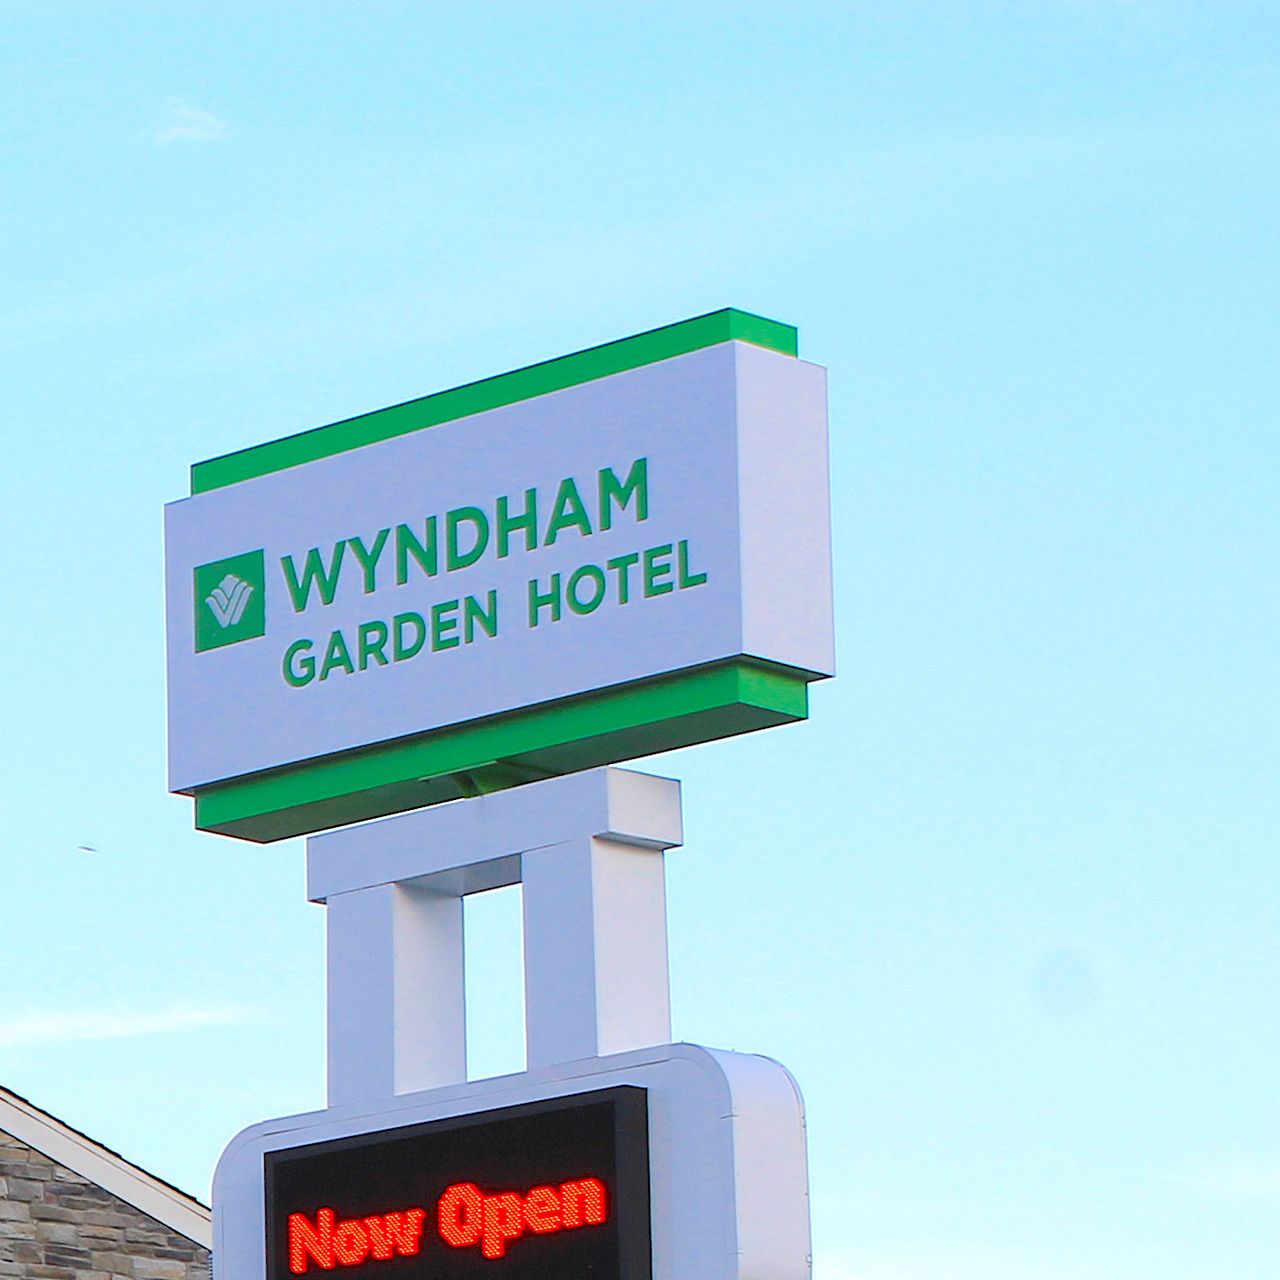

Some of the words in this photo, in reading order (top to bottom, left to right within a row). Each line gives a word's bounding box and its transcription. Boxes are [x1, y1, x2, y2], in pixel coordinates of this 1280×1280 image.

[280, 457, 648, 612] WYNDHAM
[283, 589, 498, 688] GARDEN
[528, 539, 707, 627] HOTEL
[288, 1208, 426, 1274] Now
[438, 1178, 606, 1259] Open
